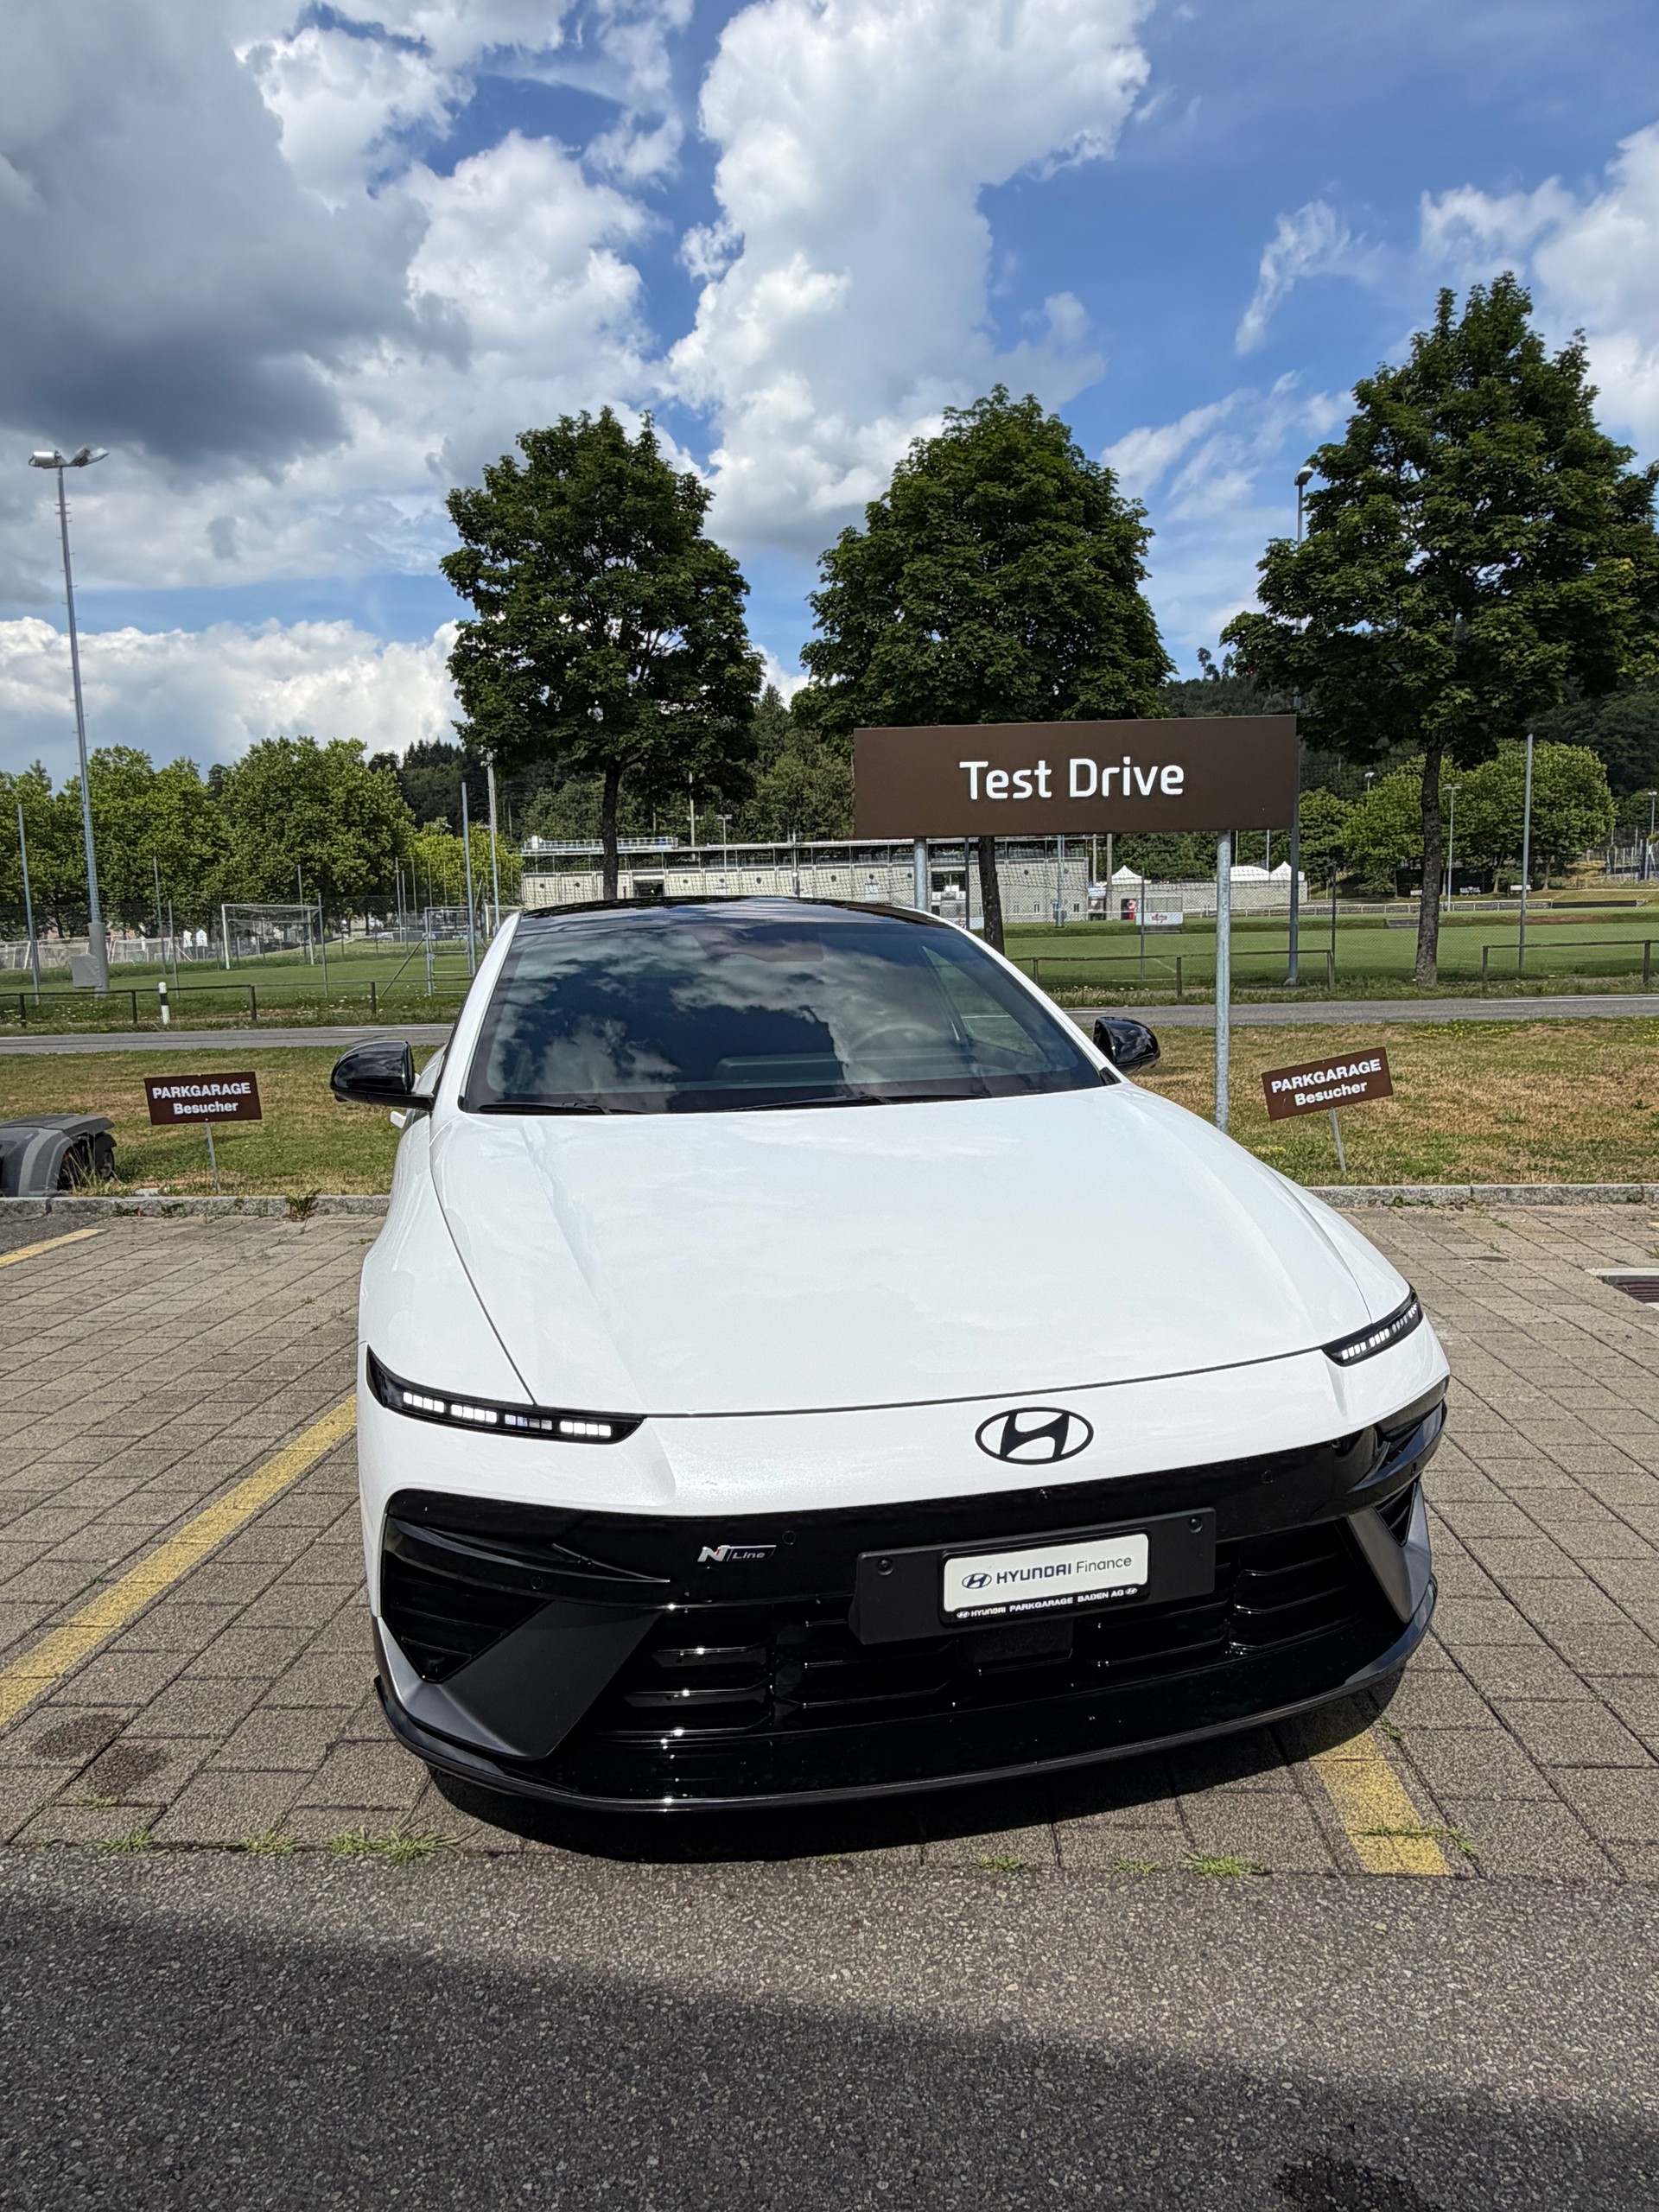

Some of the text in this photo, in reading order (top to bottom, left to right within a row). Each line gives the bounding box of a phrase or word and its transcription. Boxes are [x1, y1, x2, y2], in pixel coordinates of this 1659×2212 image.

[959, 756, 1185, 800] Test Drive
[1270, 1058, 1382, 1094] PARKGARAGE
[152, 1082, 251, 1099] PARKGARAGE
[1294, 1081, 1368, 1107] Besucher
[173, 1101, 238, 1115] Besucher
[696, 1544, 766, 1562] N Line
[996, 1555, 1132, 1585] HYUNDAI Finance
[970, 1589, 1124, 1618] HYUNDAI PARKGARAGE BADEN AG
